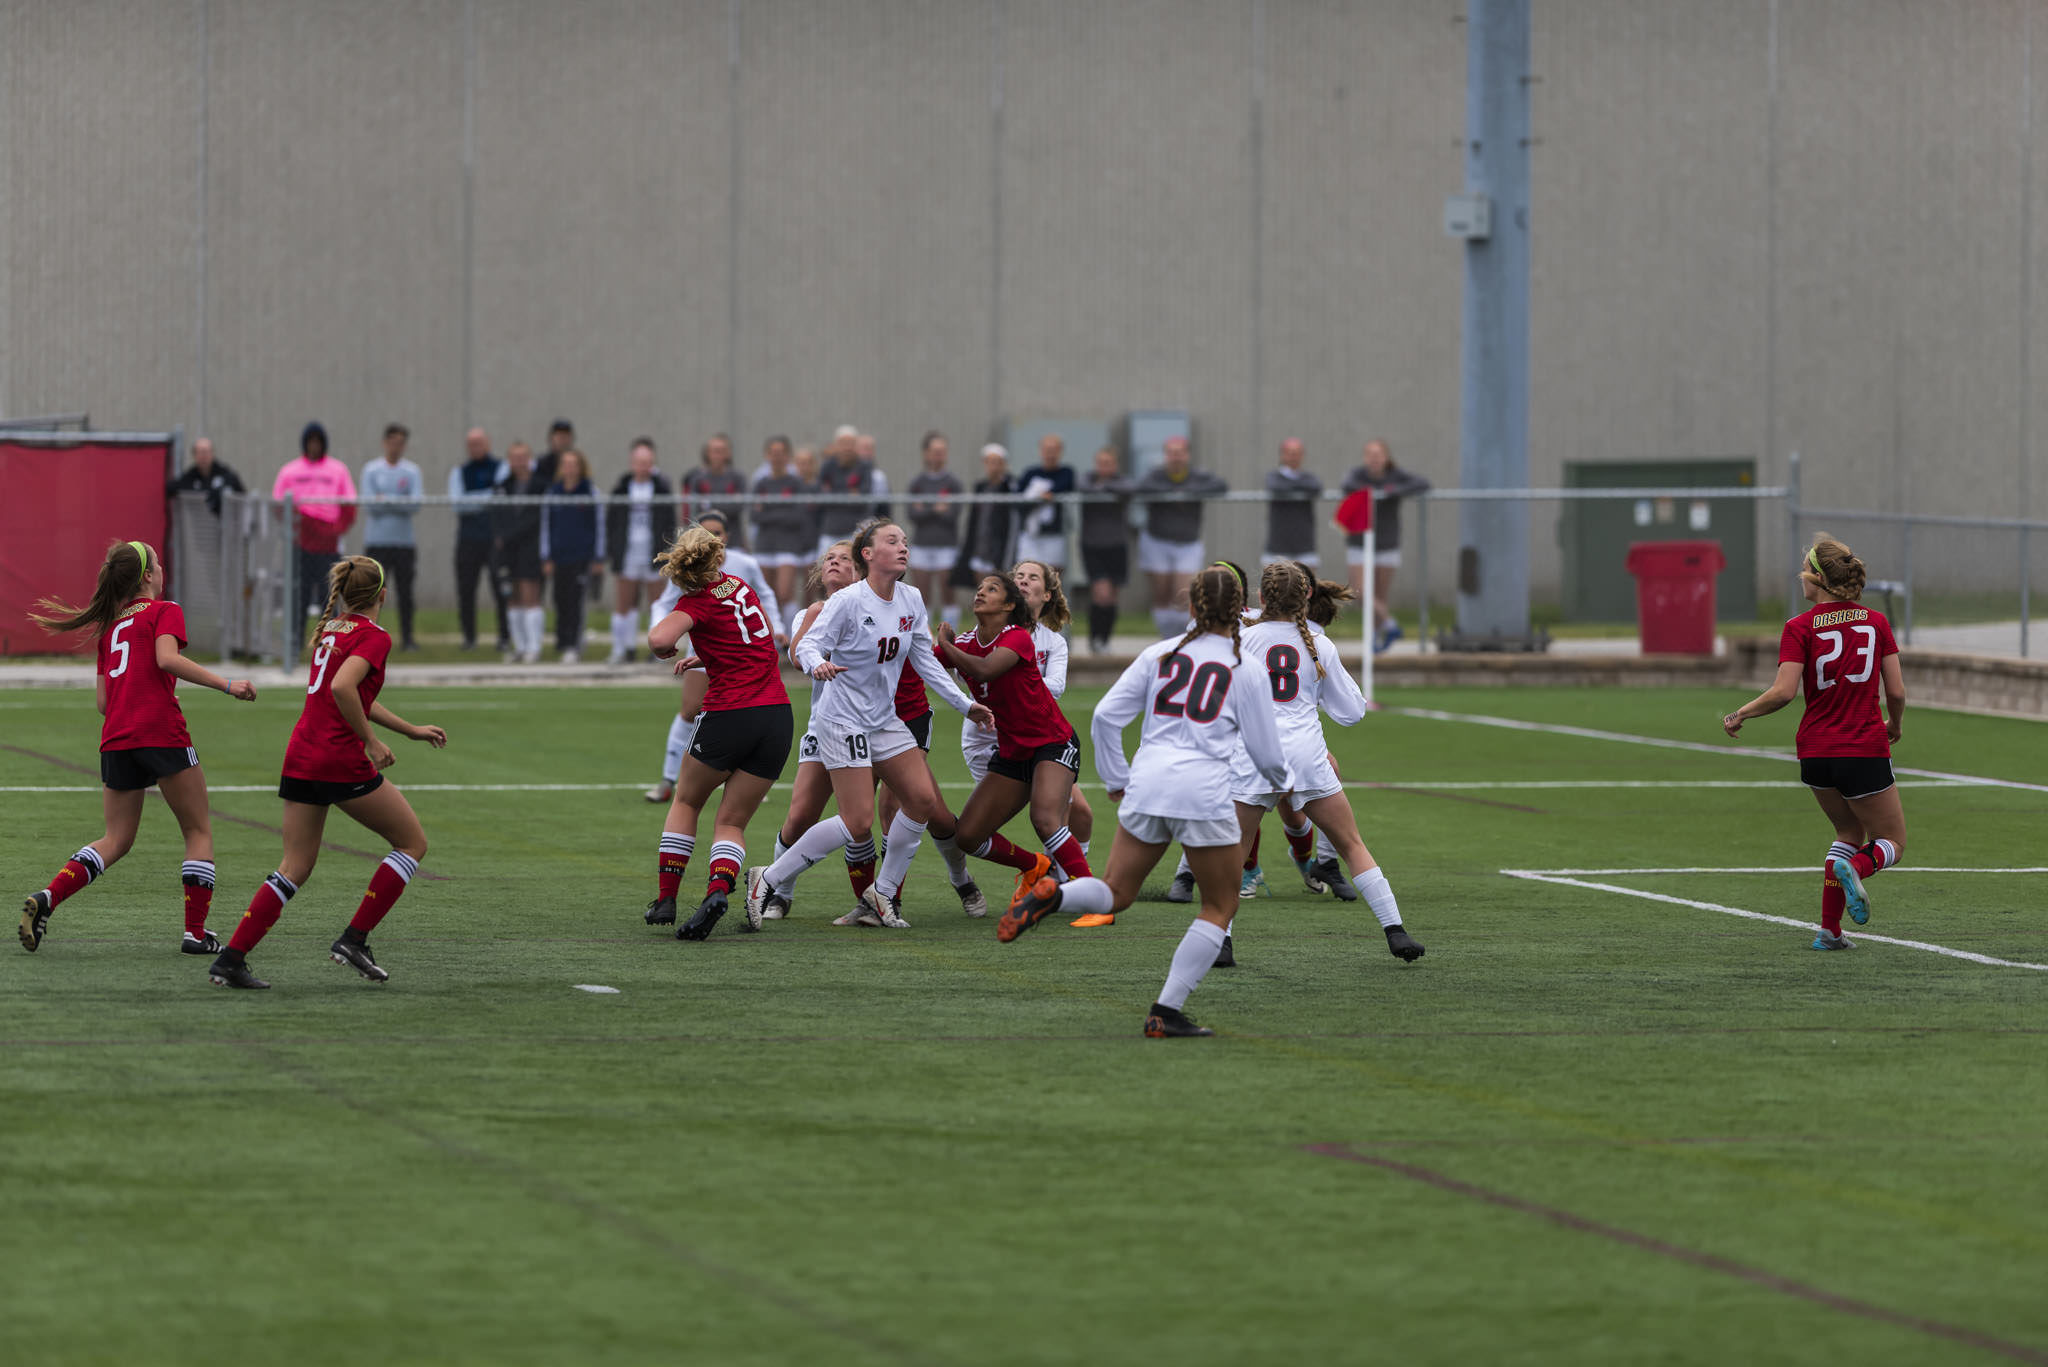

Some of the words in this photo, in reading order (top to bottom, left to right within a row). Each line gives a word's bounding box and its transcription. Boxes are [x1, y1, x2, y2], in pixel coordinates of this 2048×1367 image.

[721, 585, 769, 644] 15
[1813, 608, 1868, 628] DASHERS
[109, 617, 134, 678] 5
[308, 635, 336, 694] 9
[877, 636, 900, 664] 19
[1266, 644, 1300, 702] 8
[1816, 625, 1876, 690] 23
[1153, 652, 1232, 723] 20
[845, 733, 868, 760] 19
